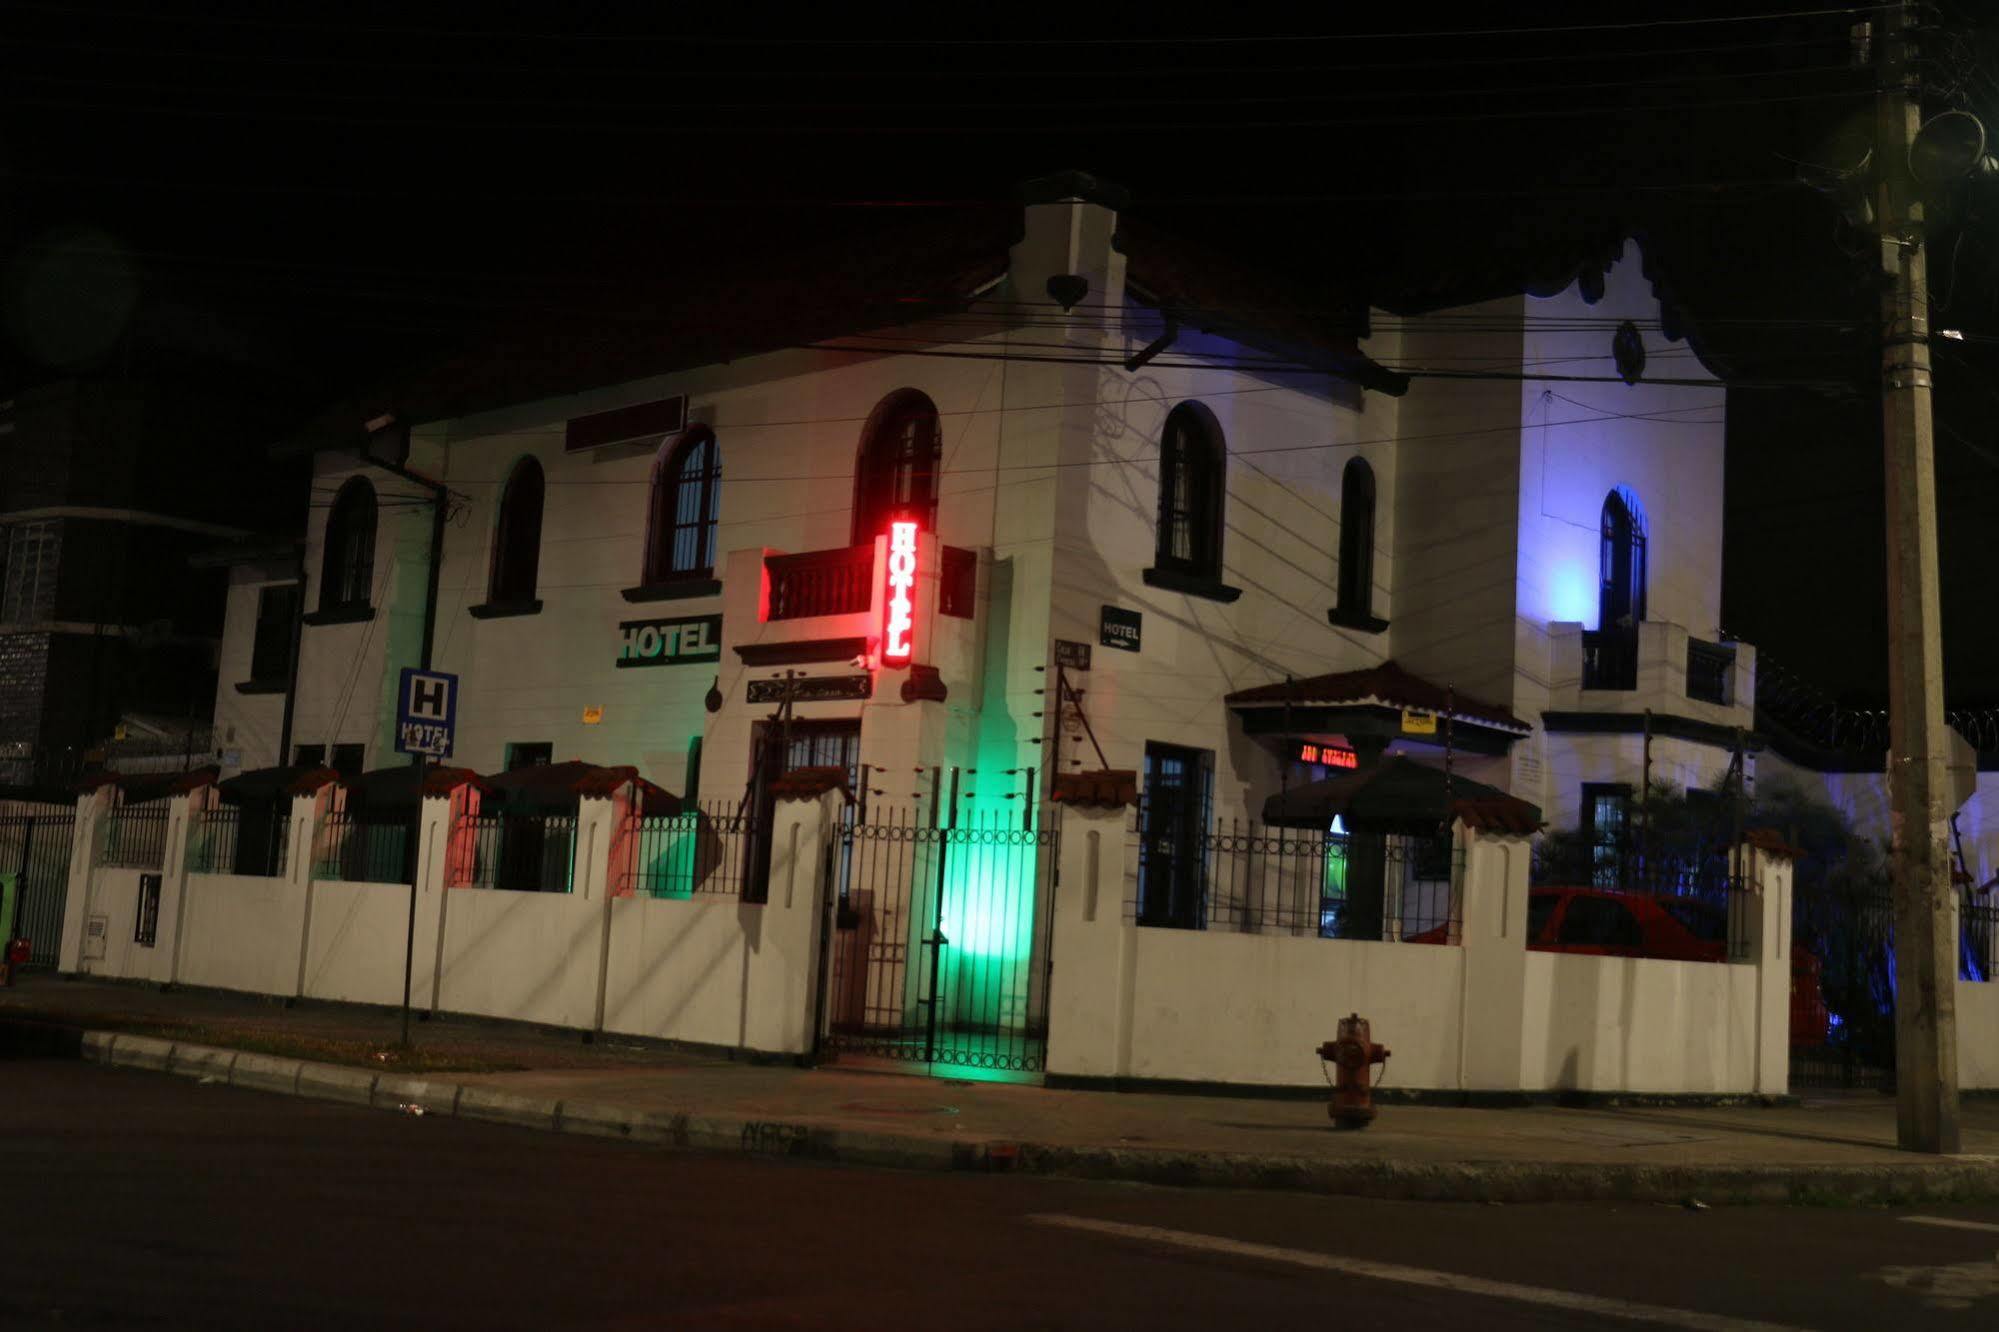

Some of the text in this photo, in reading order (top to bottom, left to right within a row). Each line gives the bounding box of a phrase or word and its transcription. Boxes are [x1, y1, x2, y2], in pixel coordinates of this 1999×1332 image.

[886, 522, 918, 656] HOTEL
[618, 622, 720, 659] HOTEL
[1103, 622, 1139, 640] HOTEL
[413, 679, 444, 716] H
[401, 721, 449, 745] HOTEL
